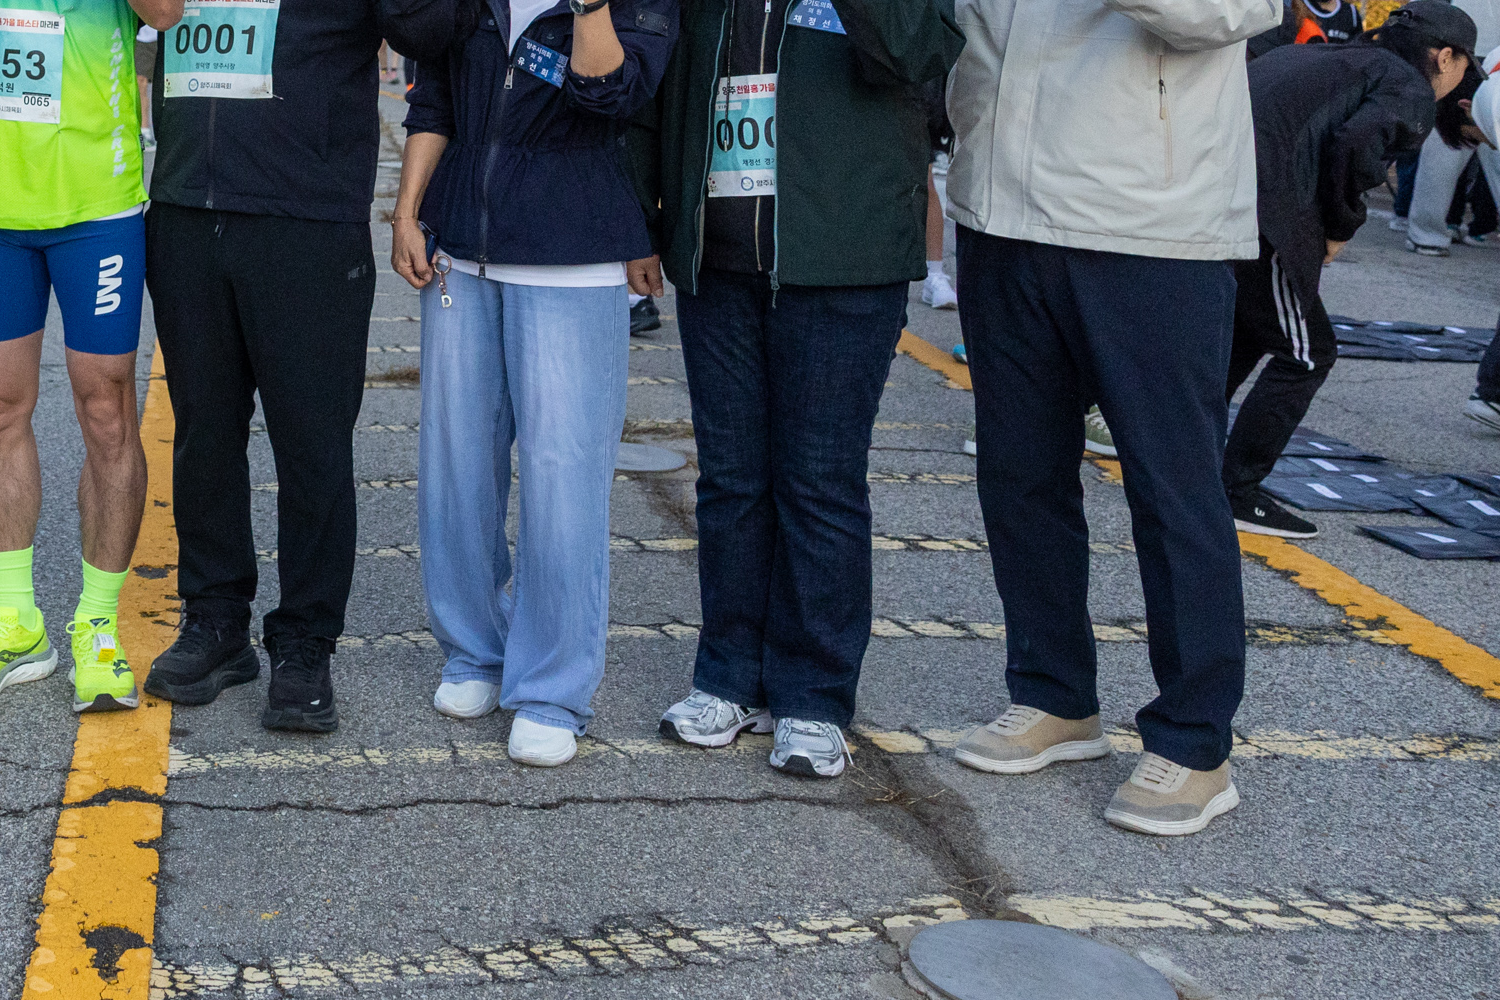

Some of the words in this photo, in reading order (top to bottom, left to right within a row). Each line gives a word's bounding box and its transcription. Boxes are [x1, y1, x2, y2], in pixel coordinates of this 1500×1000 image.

[802, 0, 832, 9] 경기도의회
[2, 17, 15, 27] 가을
[16, 19, 39, 28] 페스타
[175, 23, 256, 55] 0001
[736, 84, 759, 94] 천일홍
[760, 83, 775, 93] 가을
[24, 95, 50, 107] 0065
[111, 124, 127, 178] CREW
